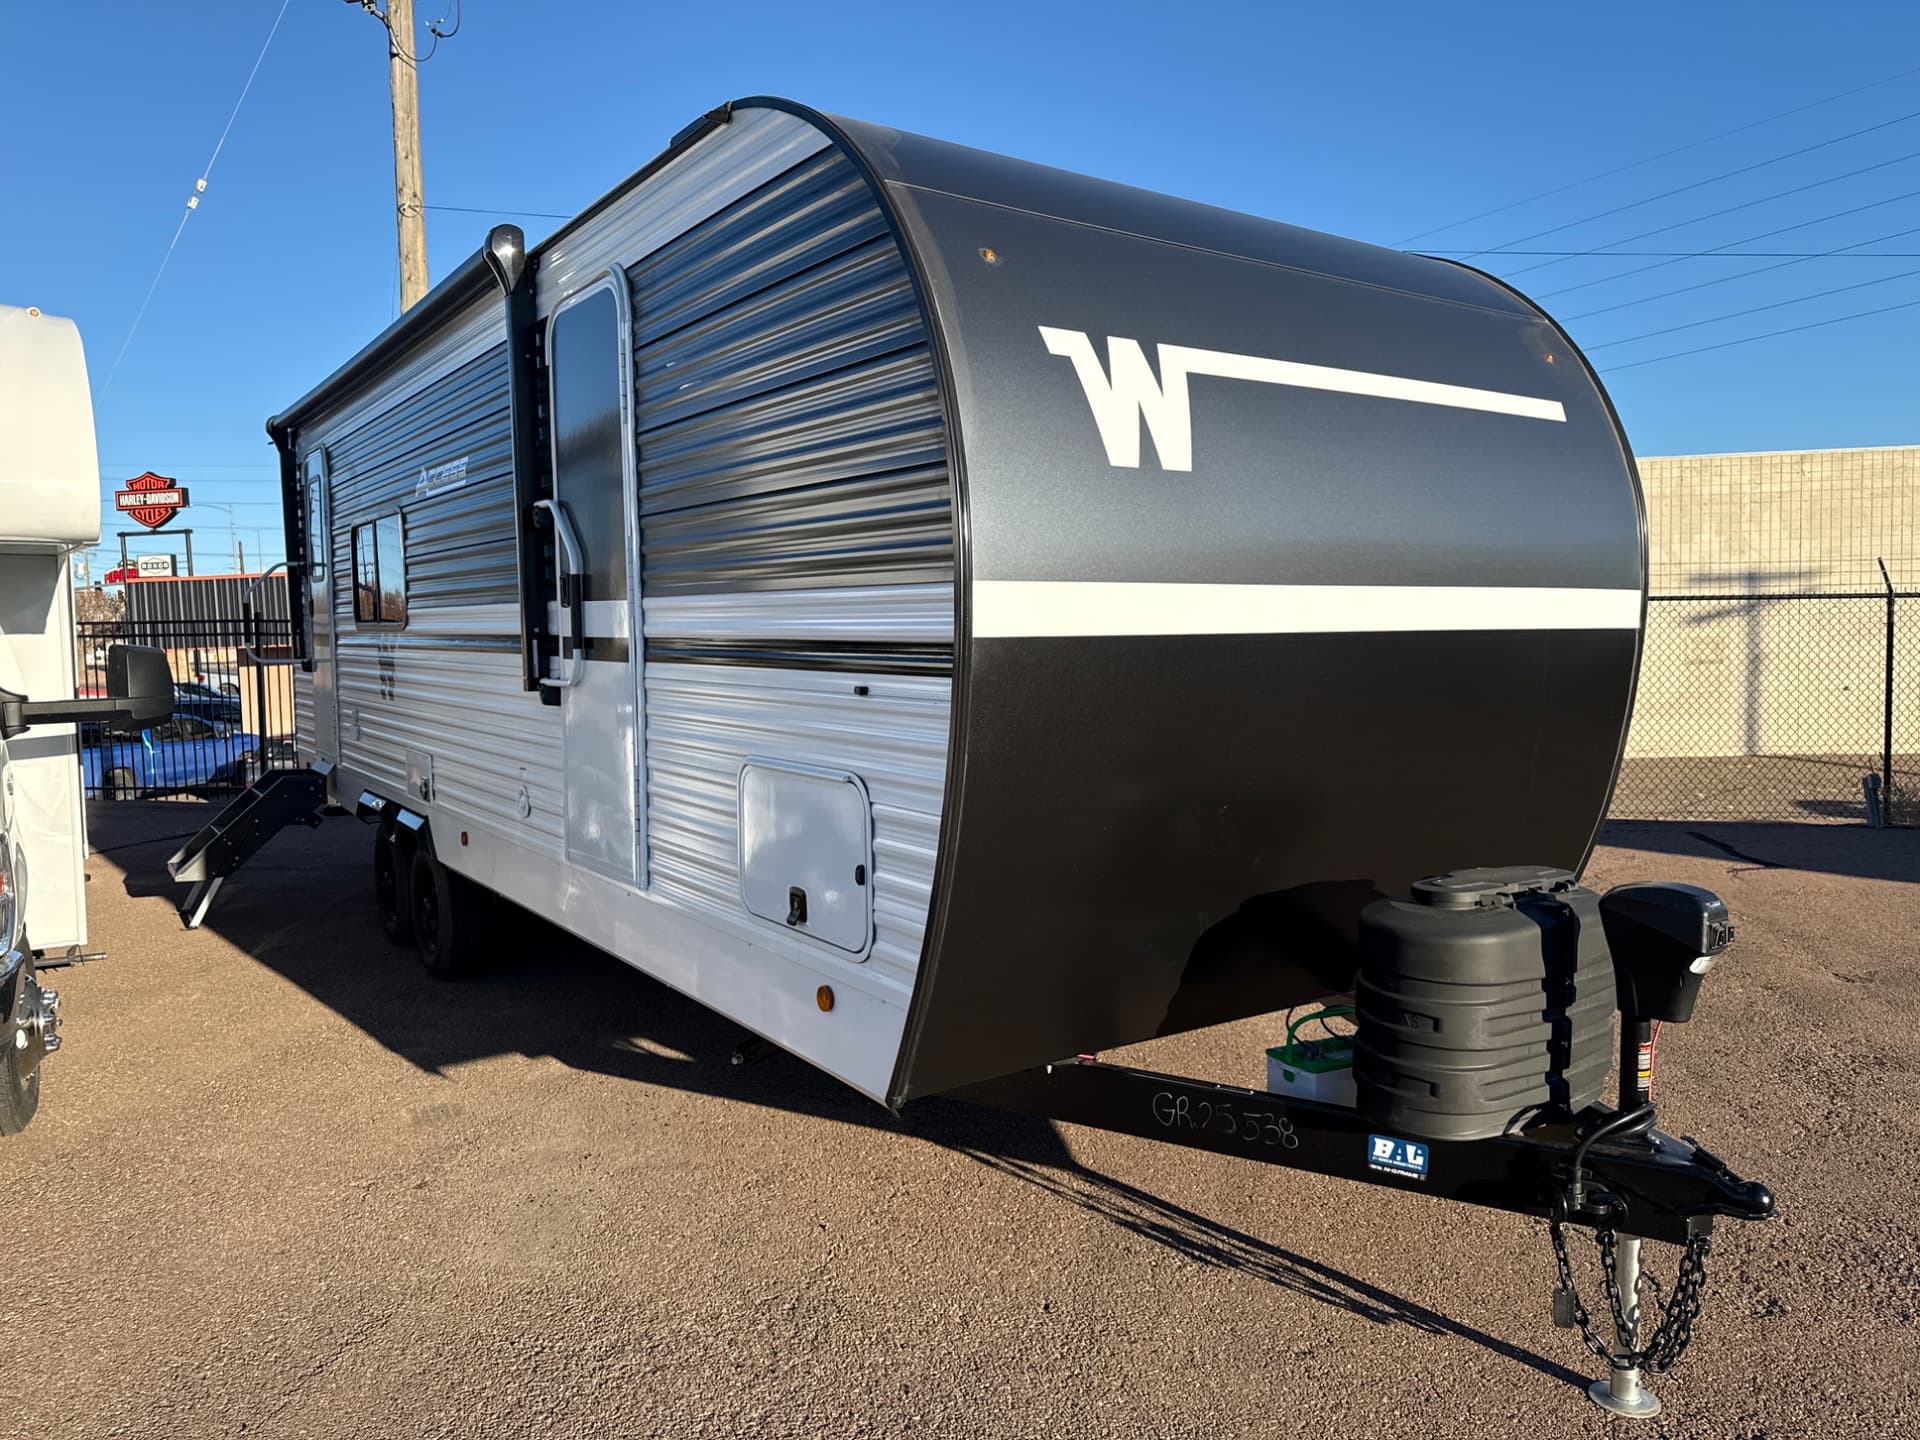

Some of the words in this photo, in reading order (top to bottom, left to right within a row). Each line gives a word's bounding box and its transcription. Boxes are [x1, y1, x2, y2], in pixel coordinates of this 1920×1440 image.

[133, 478, 164, 490] MOTOR
[119, 492, 179, 506] HARLEY-DAVIDSON
[135, 508, 167, 522] CYCLES
